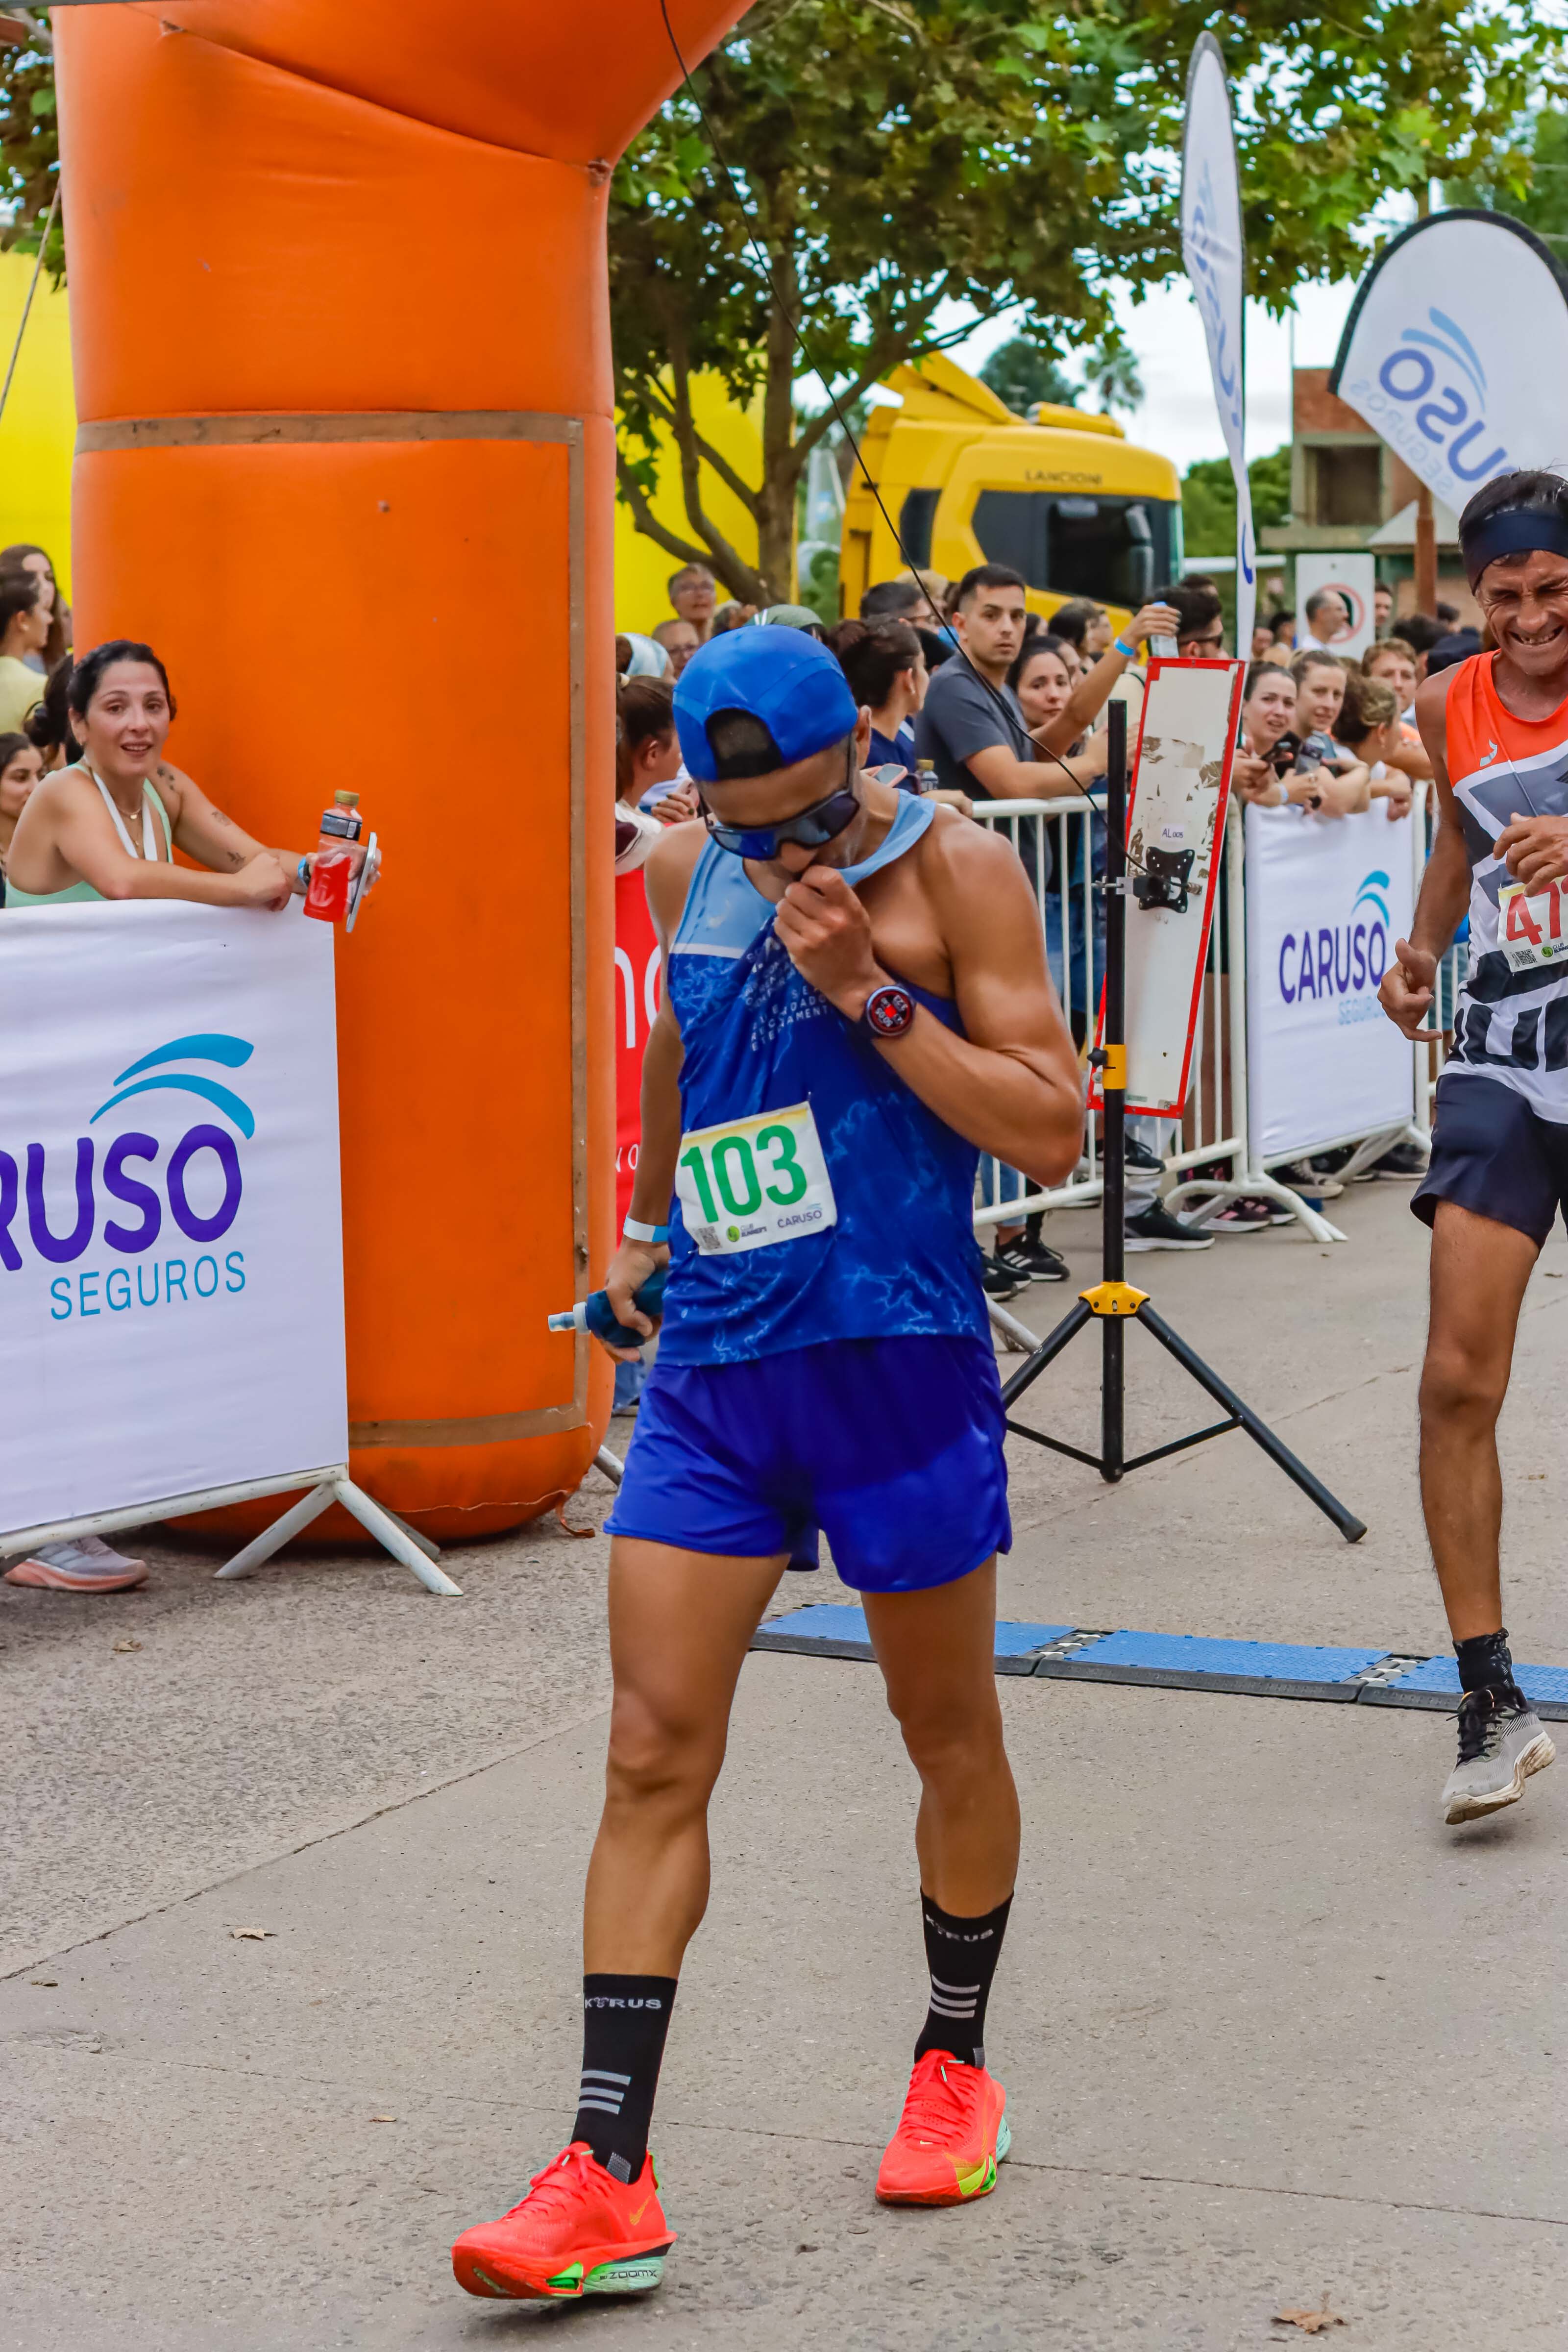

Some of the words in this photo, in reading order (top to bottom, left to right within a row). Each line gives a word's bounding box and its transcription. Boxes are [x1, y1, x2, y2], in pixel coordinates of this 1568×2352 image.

[1506, 875, 1568, 946] 47
[1279, 920, 1386, 1004] CARUSO
[680, 1125, 808, 1223] 103
[777, 1210, 822, 1228] CARUSO
[50, 1251, 245, 1320] SEGUROS
